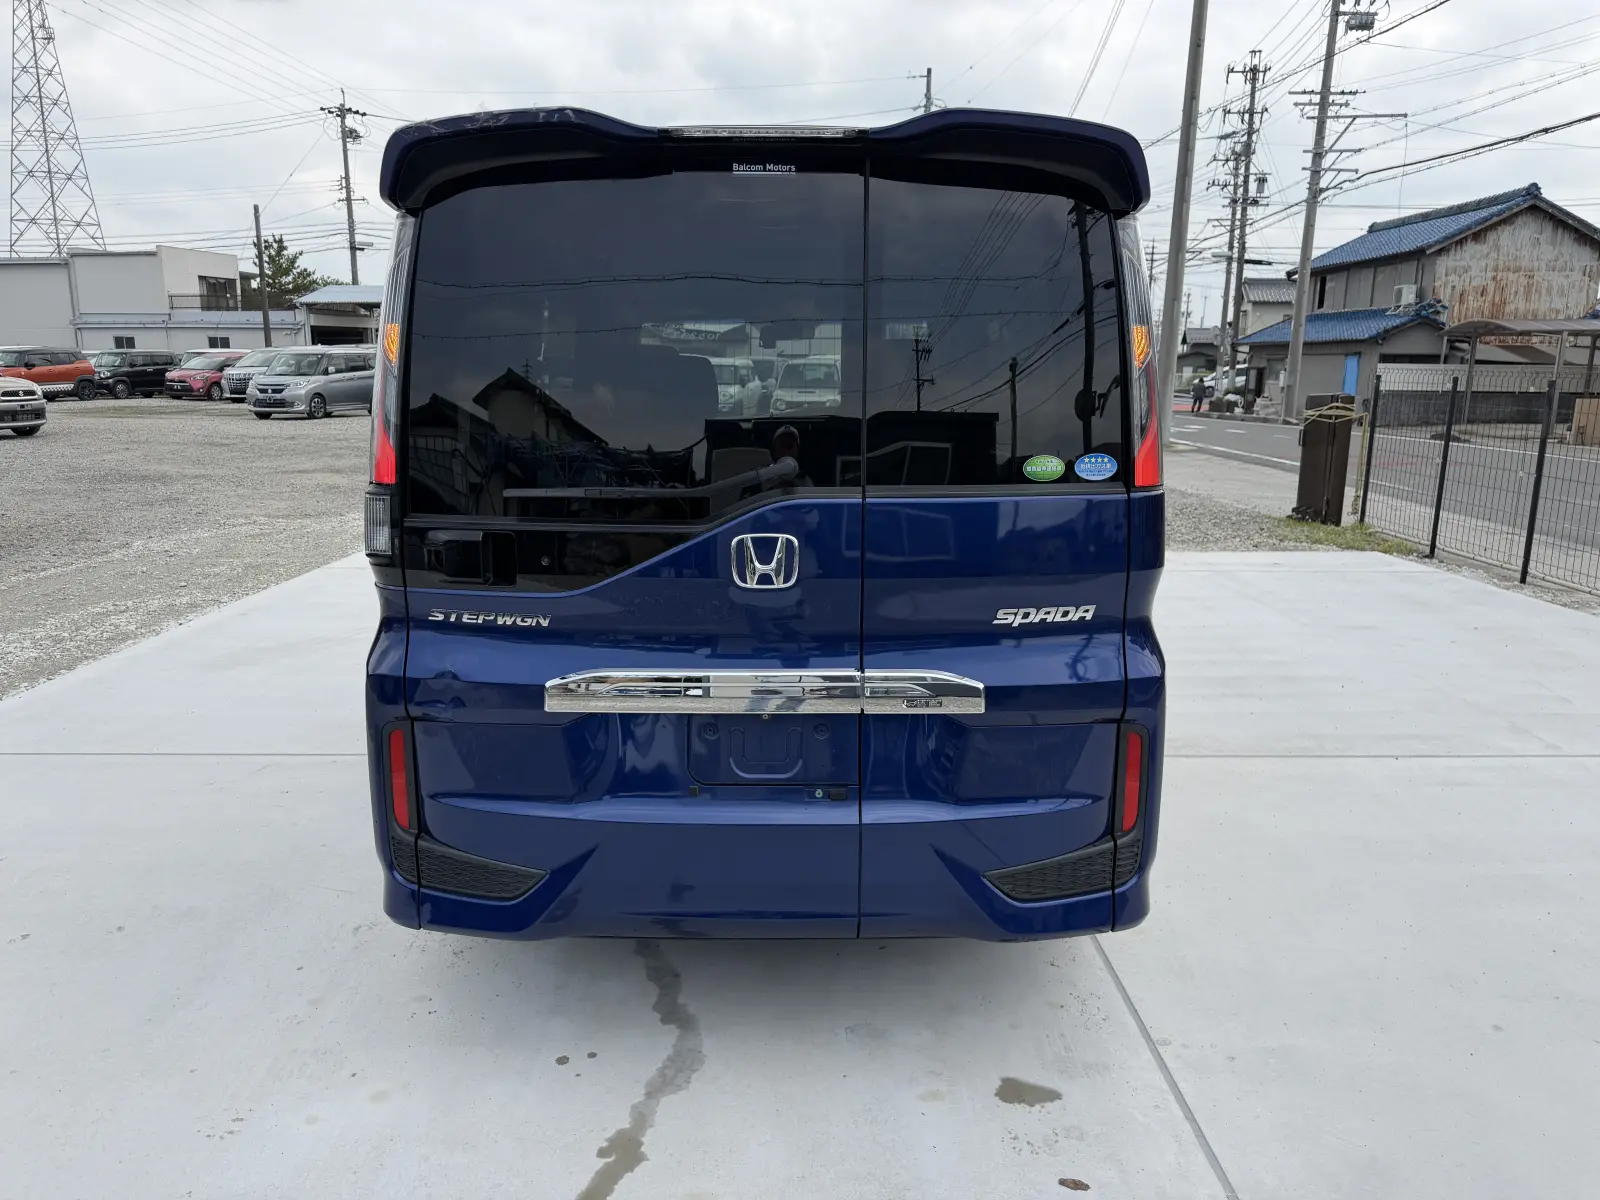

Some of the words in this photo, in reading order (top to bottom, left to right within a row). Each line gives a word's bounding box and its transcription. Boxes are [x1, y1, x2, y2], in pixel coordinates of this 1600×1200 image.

[732, 163, 763, 171] Balcom
[766, 163, 796, 171] Motors
[428, 608, 552, 627] STEPWGN
[992, 604, 1097, 627] SPADA
